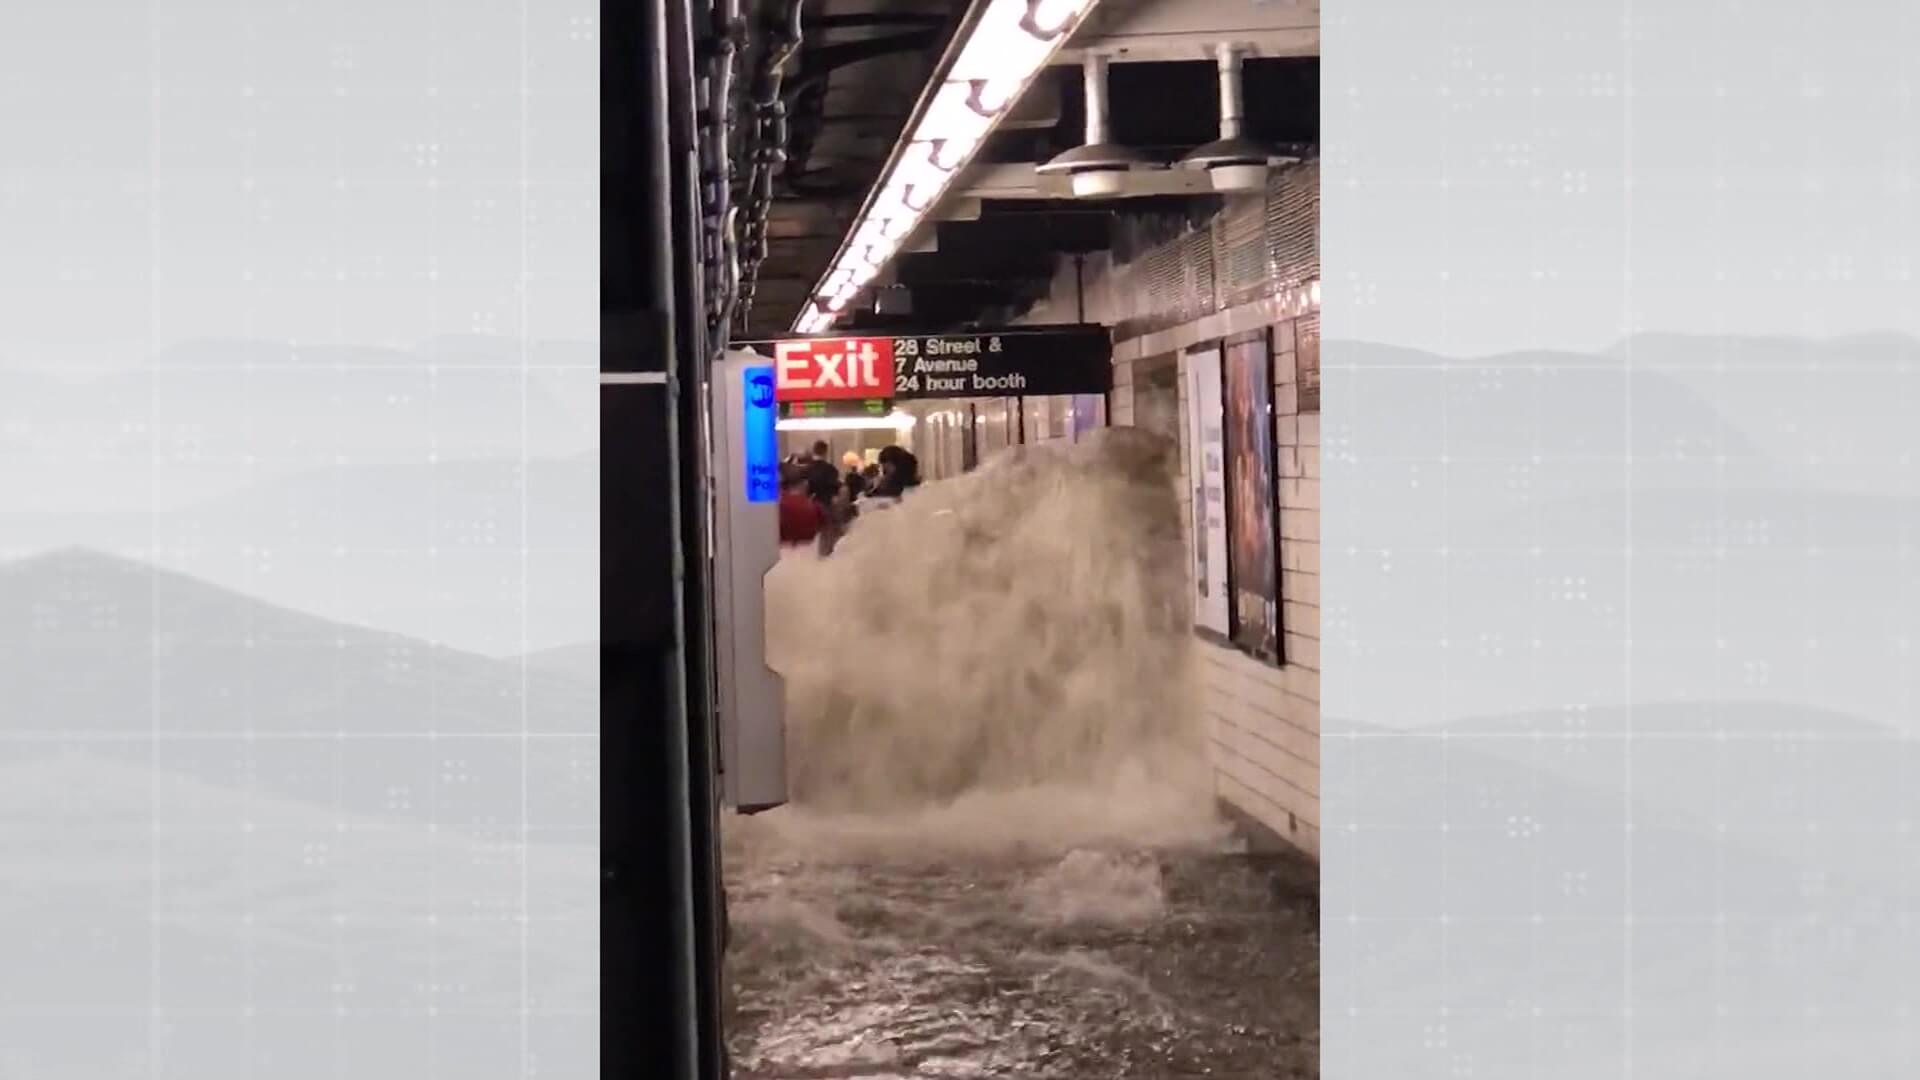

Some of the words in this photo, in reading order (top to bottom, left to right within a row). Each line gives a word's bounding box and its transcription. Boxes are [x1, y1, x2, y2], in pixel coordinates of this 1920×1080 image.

[895, 340, 919, 355] 28
[926, 337, 981, 355] Street
[988, 337, 1003, 353] &
[776, 341, 879, 389] Exit
[895, 358, 905, 373] 7
[913, 357, 978, 372] Avenue
[895, 375, 919, 391] 24
[926, 374, 966, 391] hour
[973, 373, 1026, 390] booth
